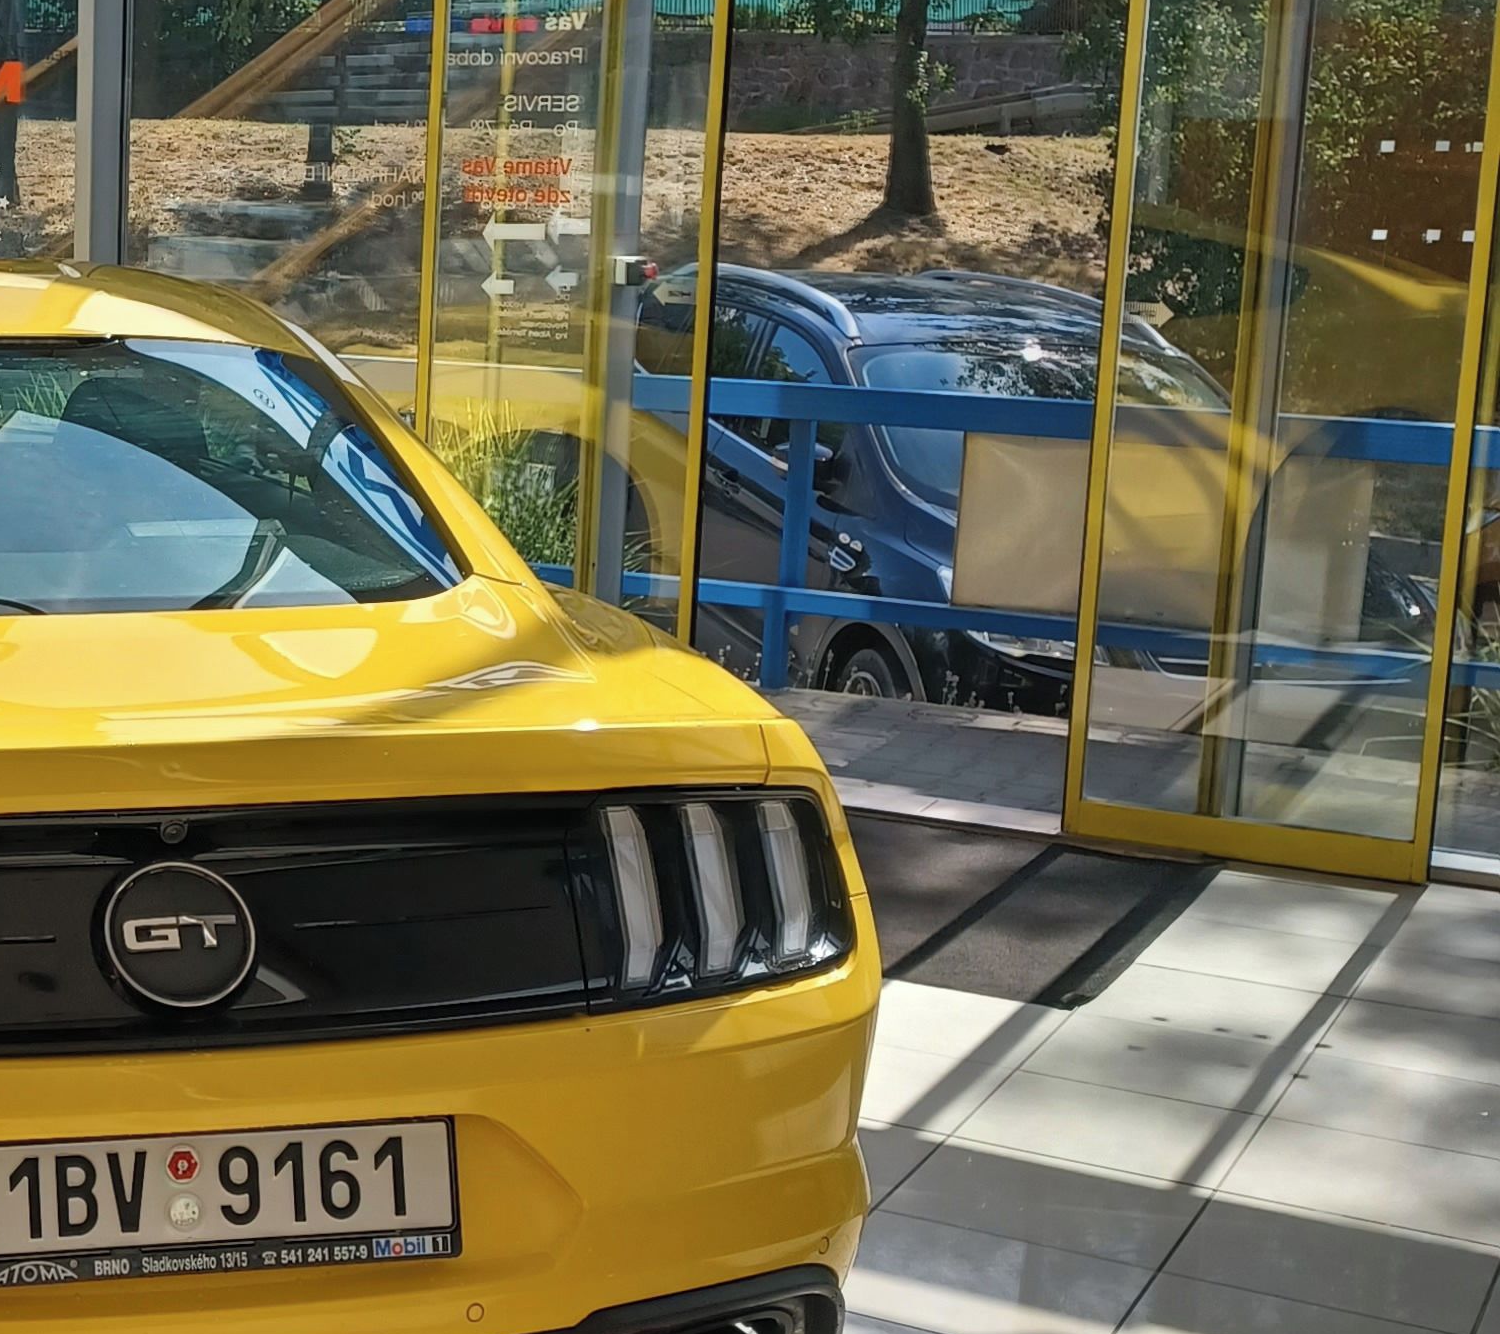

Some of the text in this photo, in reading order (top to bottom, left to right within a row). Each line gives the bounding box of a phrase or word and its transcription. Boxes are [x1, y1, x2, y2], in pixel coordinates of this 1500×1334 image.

[122, 914, 237, 953] GT
[8, 1135, 408, 1241] 1BV 9161
[94, 1258, 131, 1277] BRNO
[142, 1253, 217, 1275] Sladkovského
[219, 1251, 248, 1269] 13/15
[281, 1249, 303, 1265] 541
[307, 1246, 330, 1263] 241
[333, 1244, 368, 1261] 557-9
[374, 1237, 426, 1257] Mobil
